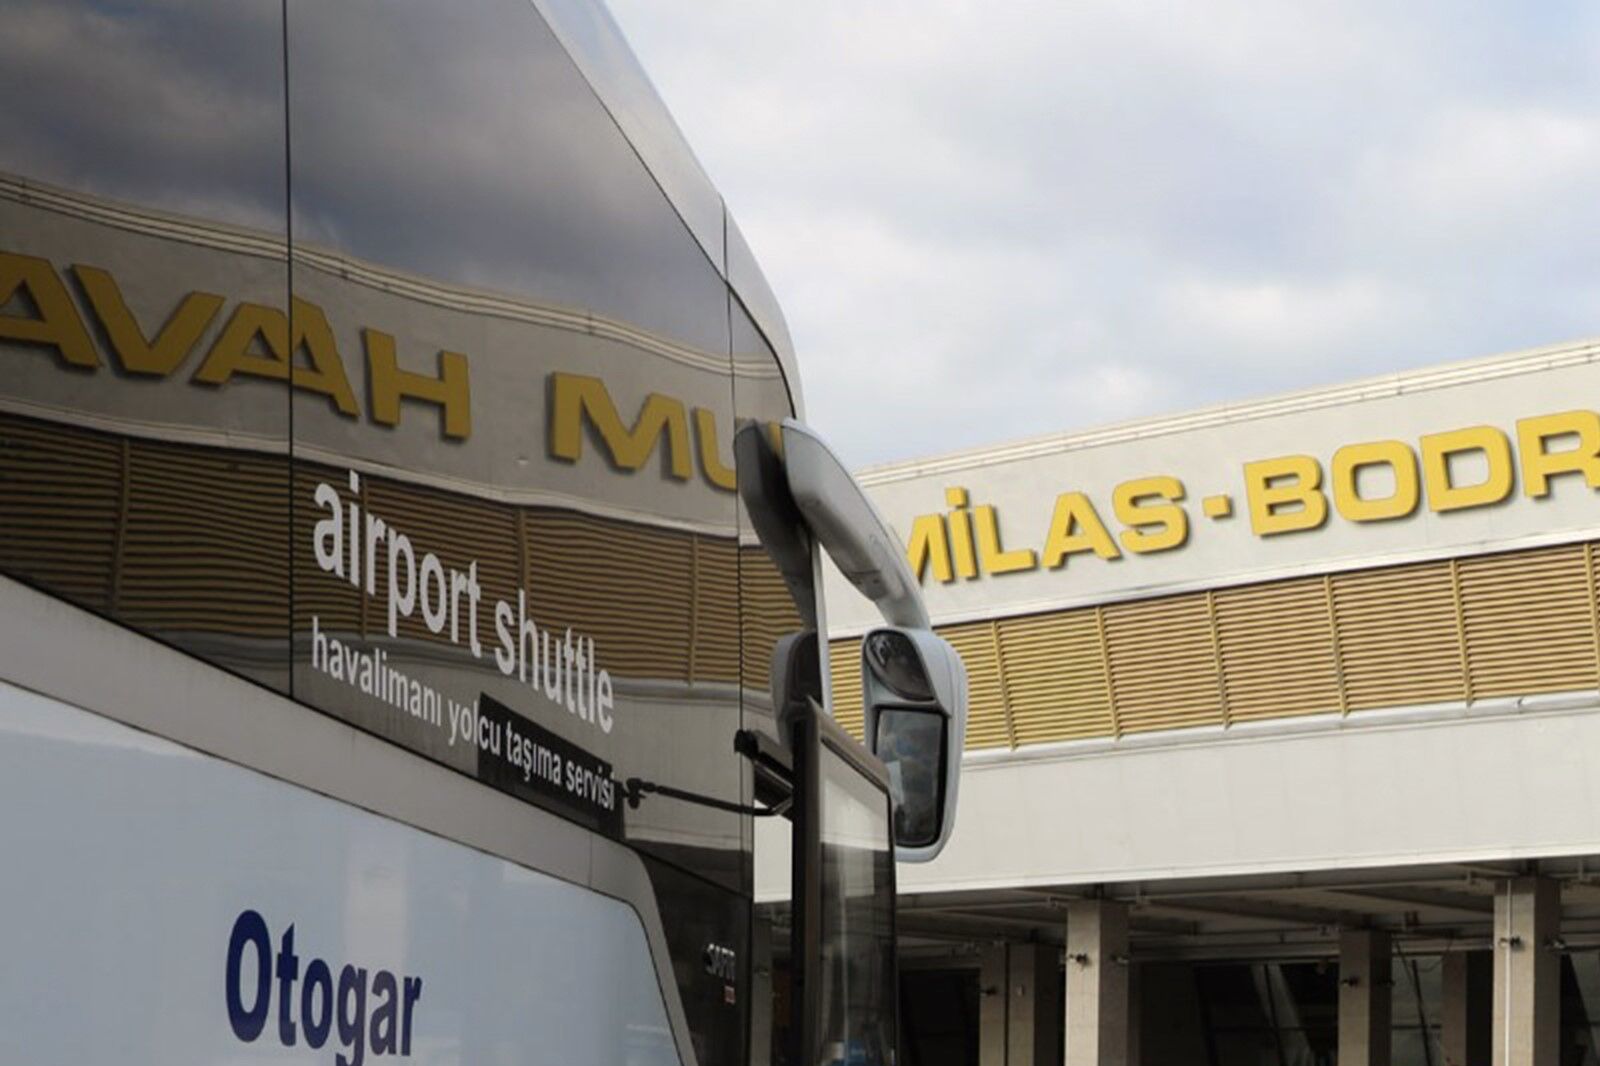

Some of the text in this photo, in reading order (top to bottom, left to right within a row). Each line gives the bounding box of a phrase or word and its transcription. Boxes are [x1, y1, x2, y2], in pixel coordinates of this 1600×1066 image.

[312, 615, 615, 811] havalimanı yolcu taşıma servisi
[313, 470, 614, 734] airport shuttle
